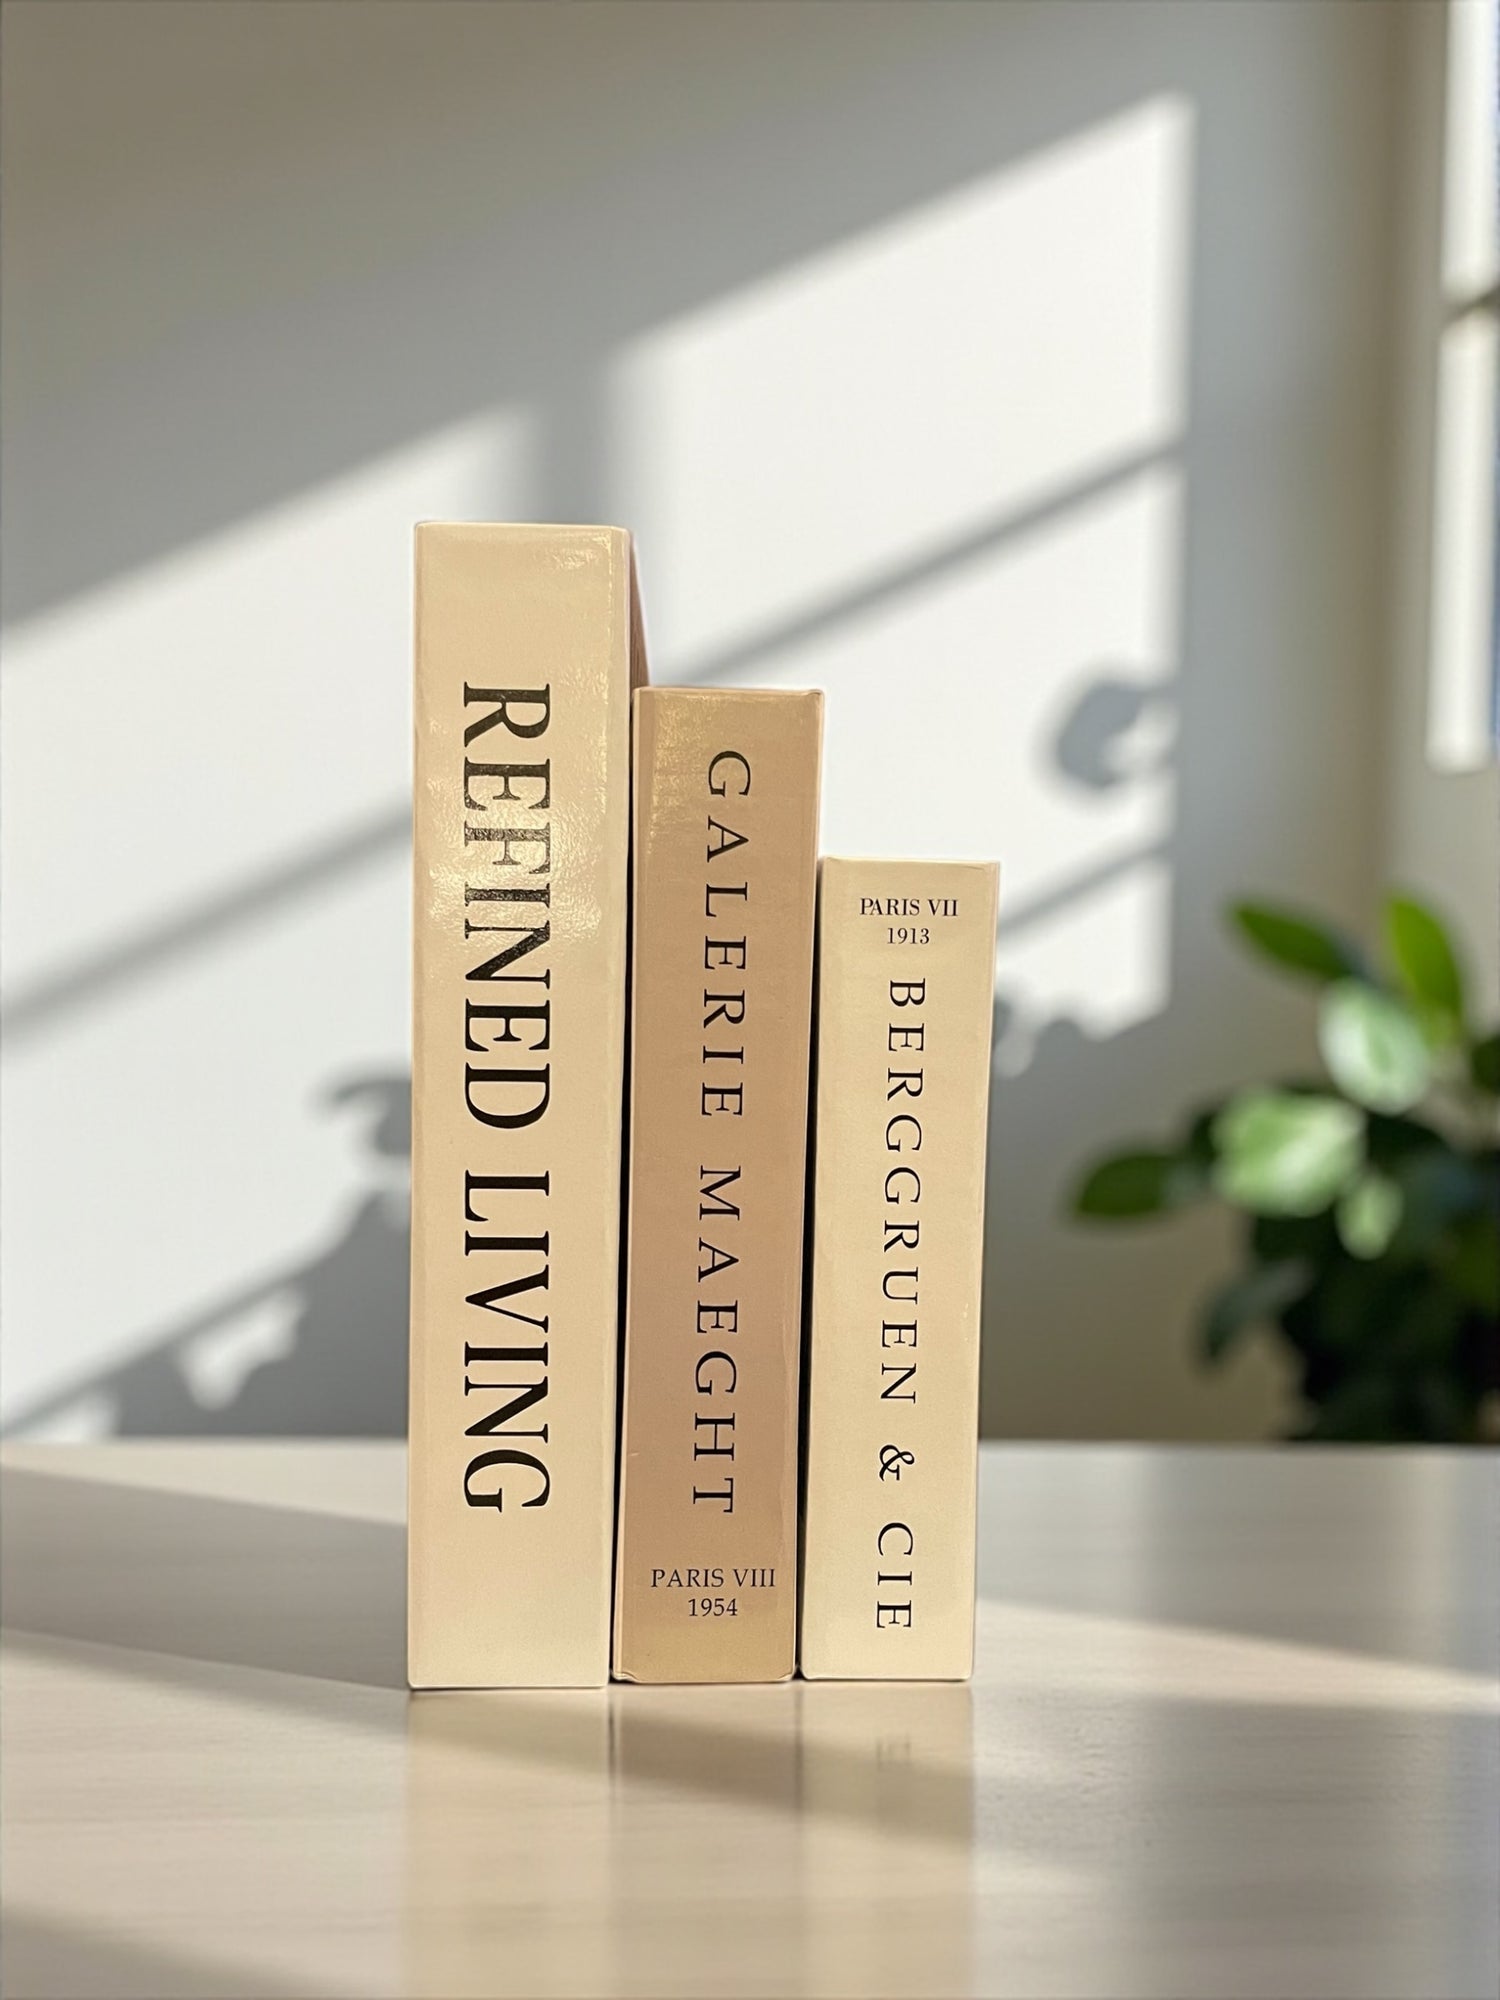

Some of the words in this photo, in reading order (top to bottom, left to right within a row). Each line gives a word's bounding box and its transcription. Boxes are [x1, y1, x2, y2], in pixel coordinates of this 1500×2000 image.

[462, 681, 552, 1130] REFINED
[700, 749, 752, 1119] GALERIE
[859, 897, 921, 918] PARIS
[926, 897, 959, 918] VII
[885, 926, 931, 946] 1913
[879, 977, 927, 1406] BERGGRUEN
[462, 1168, 552, 1515] LIVING
[691, 1163, 743, 1516] MAEGHT
[877, 1443, 916, 1483] &
[650, 1567, 726, 1589] PARIS
[731, 1567, 777, 1589] VIII
[687, 1596, 739, 1618] 1954
[875, 1521, 915, 1630] CIE
